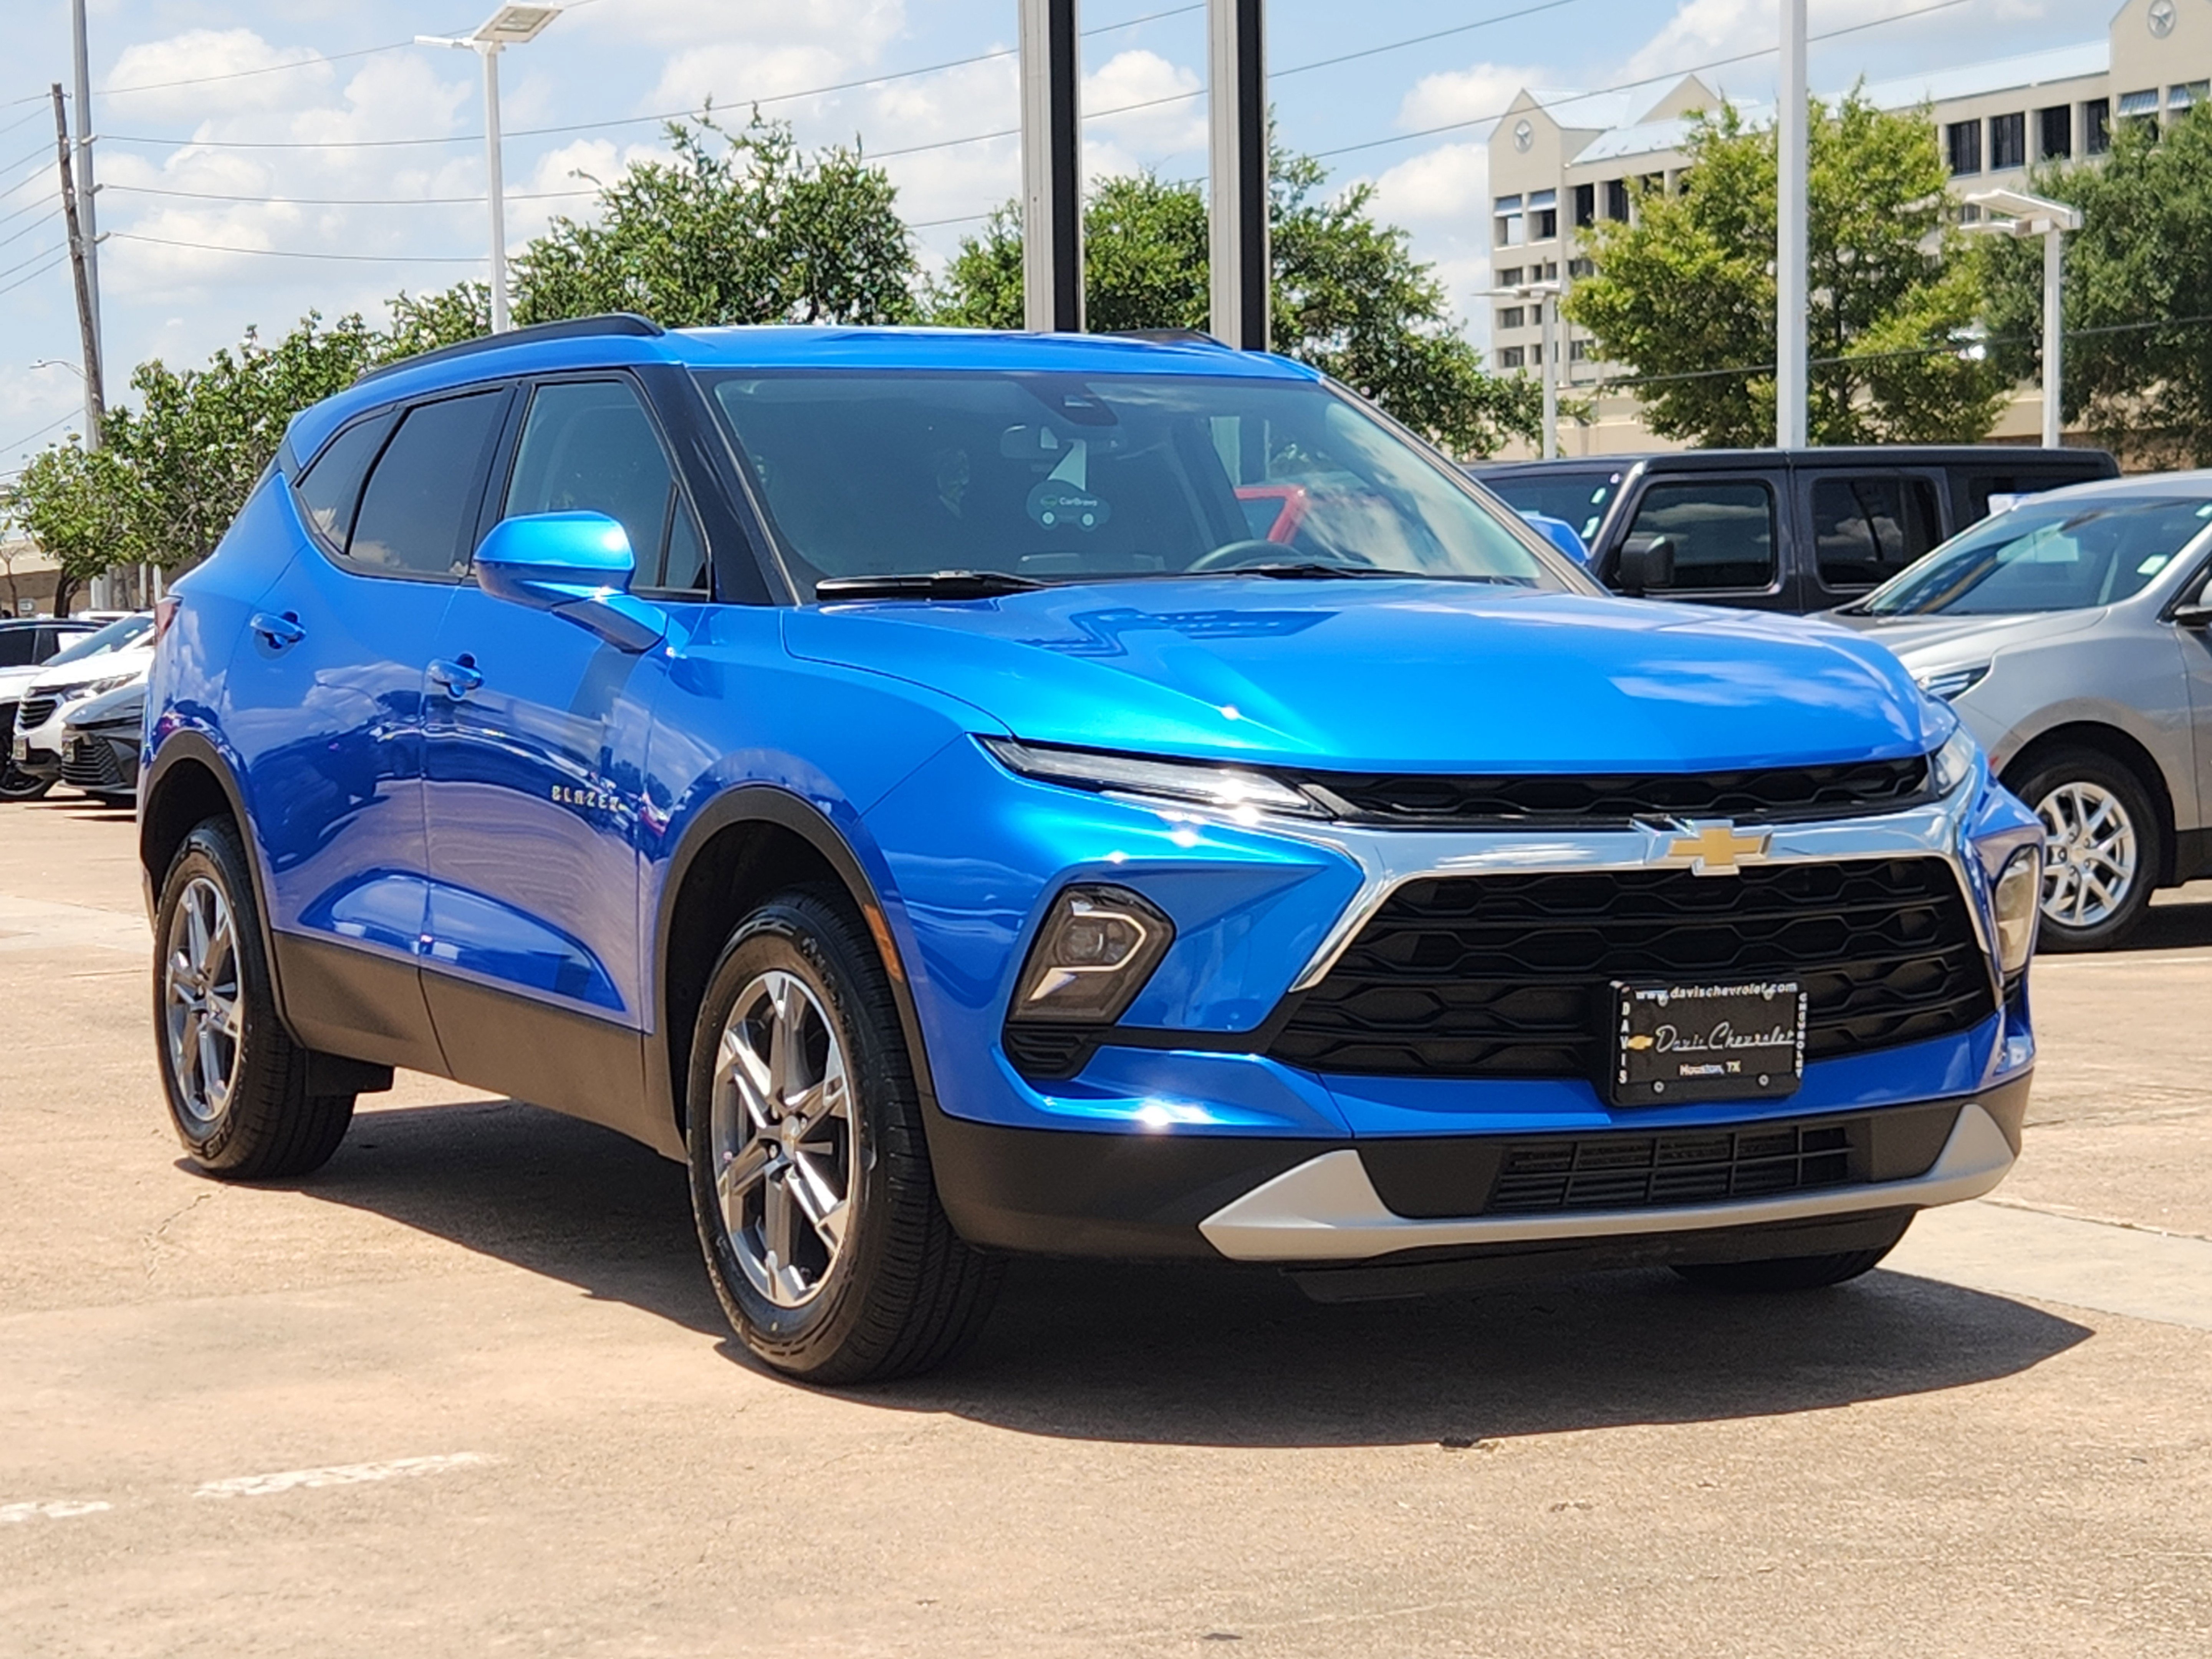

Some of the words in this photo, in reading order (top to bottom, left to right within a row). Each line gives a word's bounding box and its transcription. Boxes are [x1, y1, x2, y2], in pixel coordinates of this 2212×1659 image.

[551, 785, 619, 813] BLAZER
[1635, 982, 1798, 999] www.davischevrolet.com
[1618, 1001, 1630, 1084] DAVIS
[1655, 1023, 1708, 1053] Davis
[1708, 1021, 1796, 1050] Chevrolet
[1726, 1060, 1741, 1073] TX
